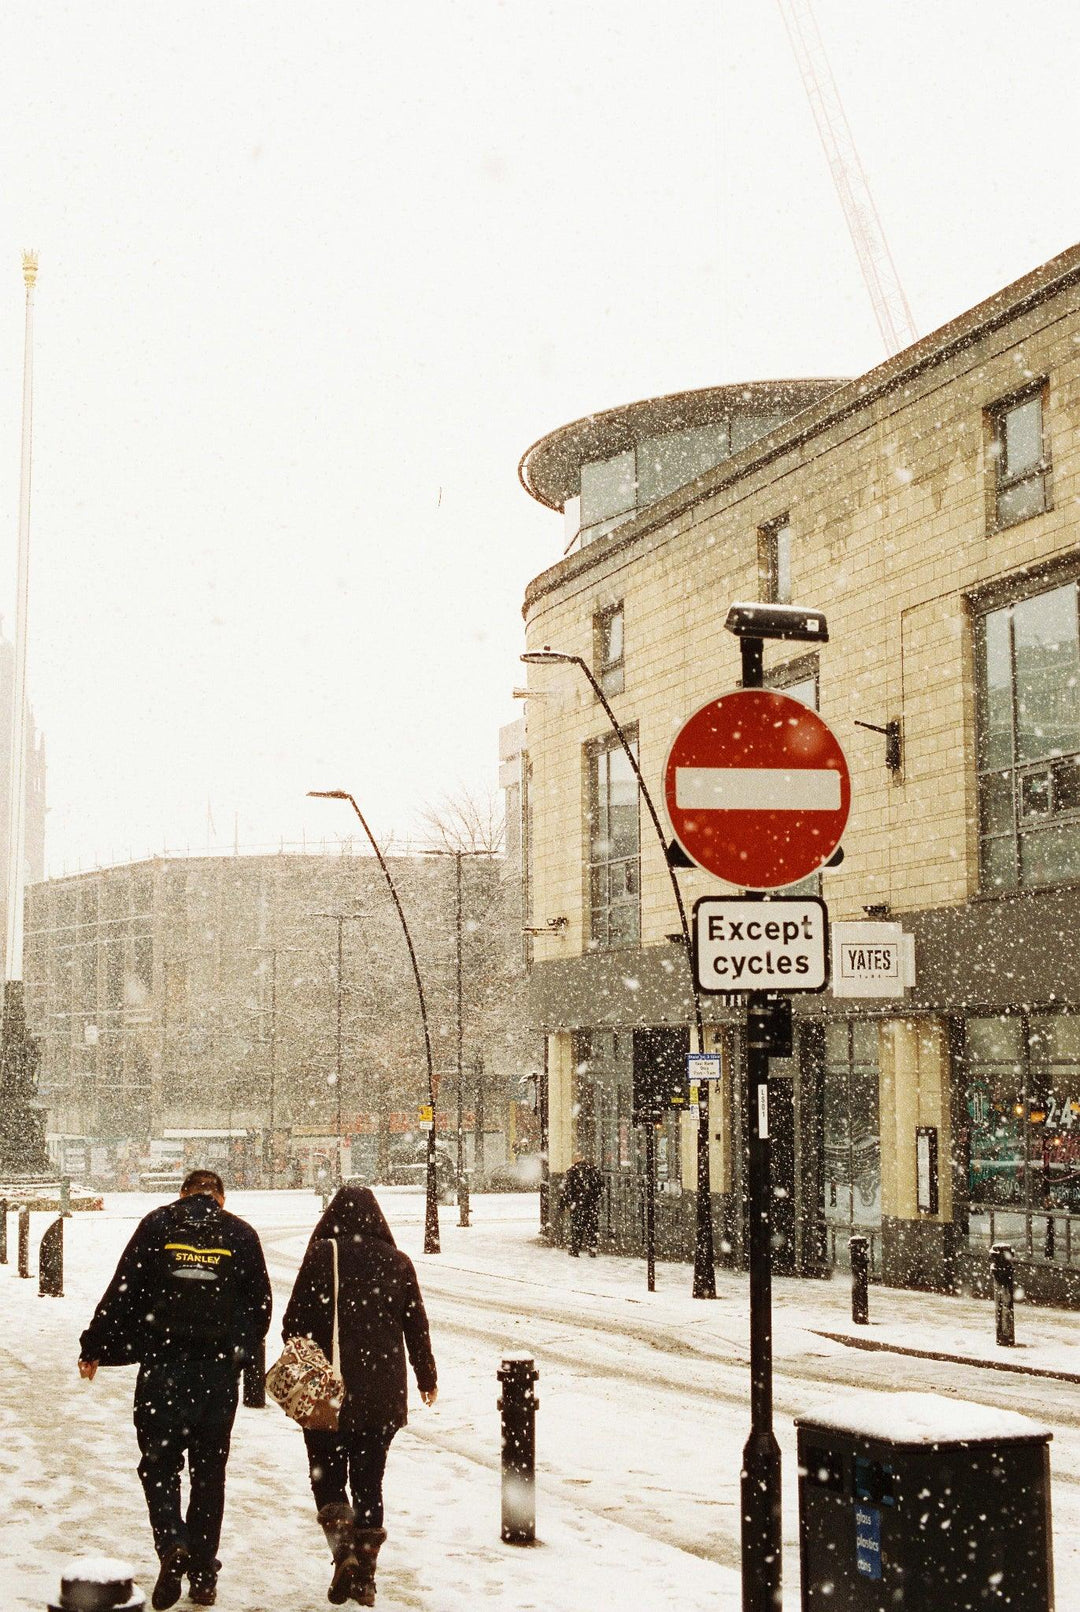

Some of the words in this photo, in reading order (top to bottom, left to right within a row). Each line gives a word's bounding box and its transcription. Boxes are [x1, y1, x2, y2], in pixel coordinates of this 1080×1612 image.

[708, 915, 813, 944] Except
[713, 951, 810, 980] cycles
[848, 949, 891, 970] YATES
[175, 1252, 221, 1264] STANLEY
[856, 1509, 872, 1525] glass
[857, 1533, 879, 1552] plastics
